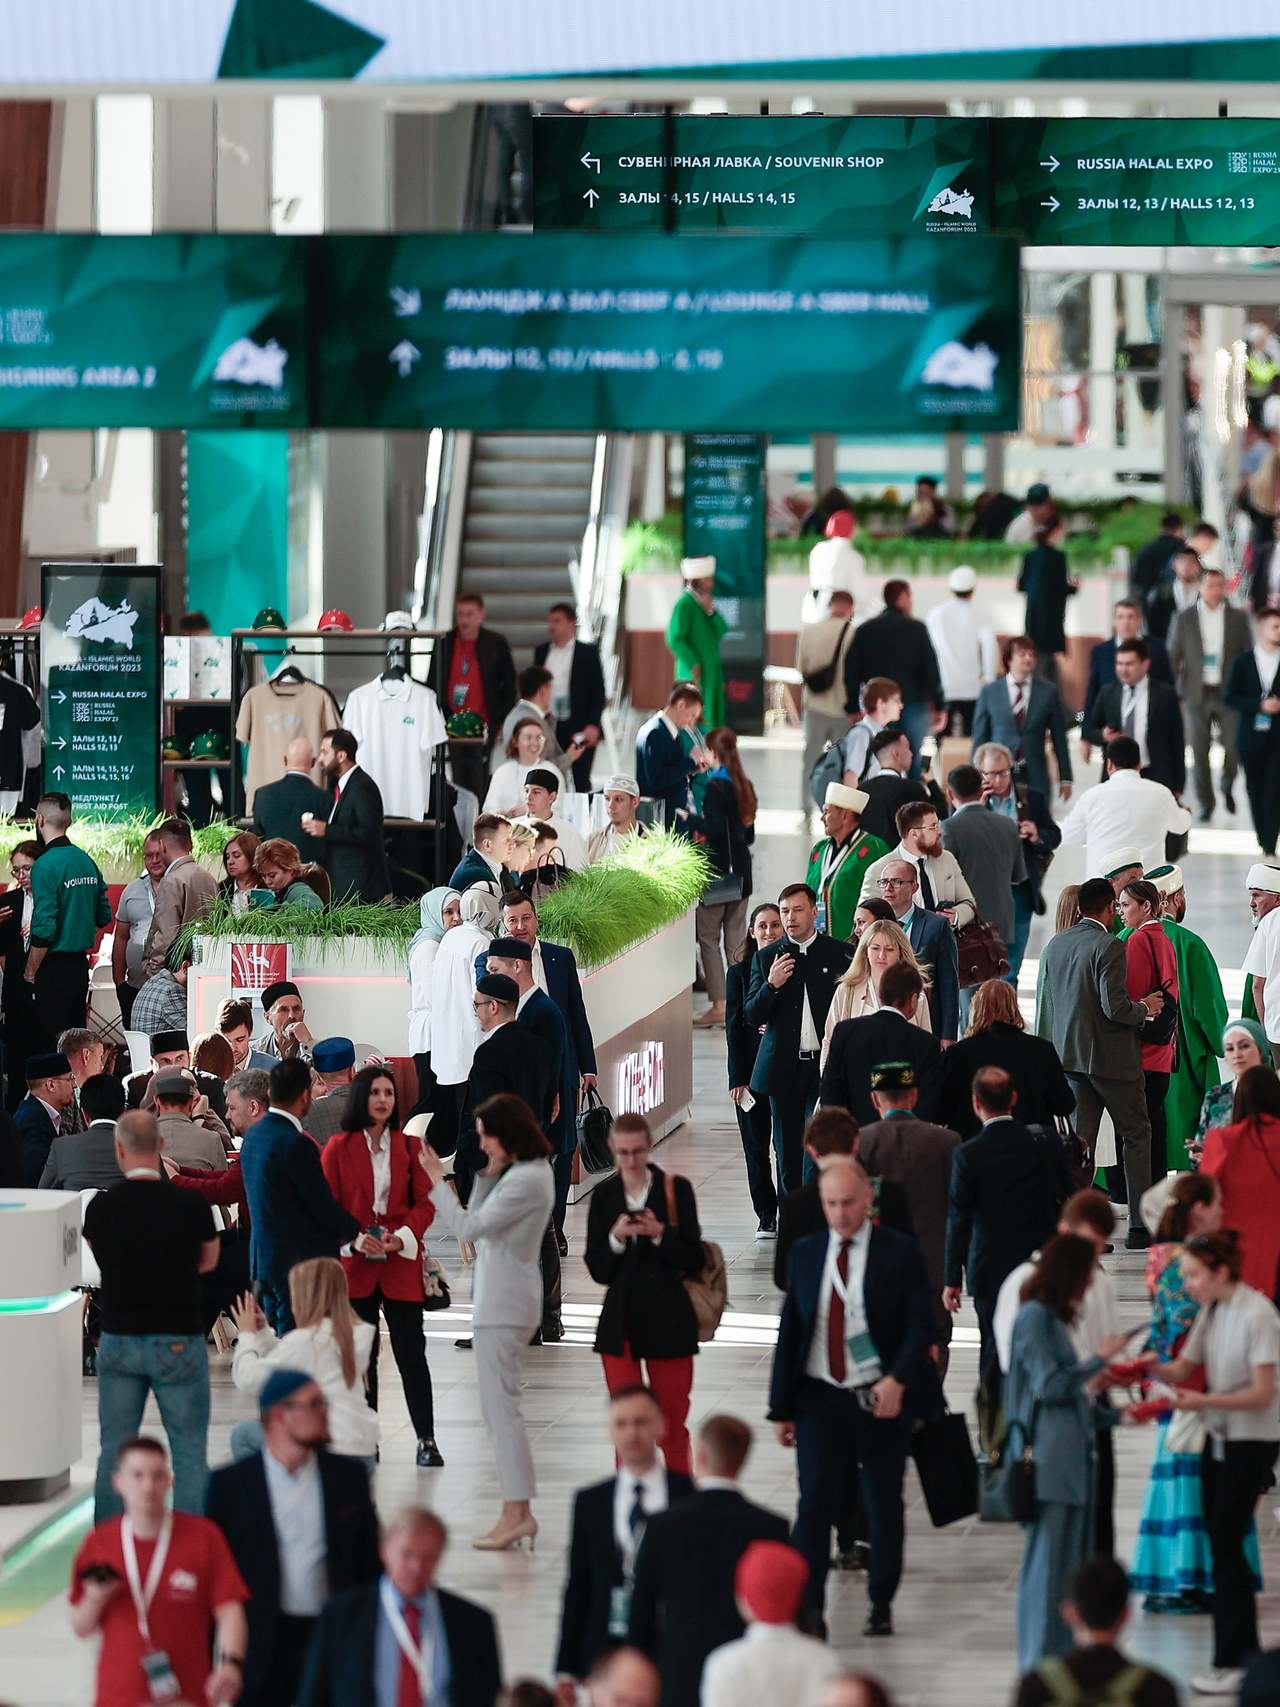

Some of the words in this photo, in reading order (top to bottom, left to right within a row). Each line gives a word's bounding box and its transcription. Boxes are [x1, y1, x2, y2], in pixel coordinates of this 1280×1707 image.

[713, 156, 762, 168] ЛАВКА
[764, 155, 772, 170] /
[774, 156, 844, 168] SOUVENIR
[847, 156, 885, 168] SHOP
[1077, 158, 1126, 170] RUSSIA
[1128, 158, 1174, 170] HALAL
[1176, 158, 1213, 170] EXPO
[618, 192, 660, 204] ЗАЛЫ
[663, 192, 682, 206] 4,
[685, 192, 700, 204] 15
[702, 191, 710, 206] /
[712, 192, 754, 204] HALLS
[757, 192, 778, 206] 14,
[780, 192, 796, 204] 15
[1077, 198, 1119, 210] ЗАЛЫ
[1122, 198, 1141, 212] 12,
[1144, 198, 1159, 210] 13
[1160, 197, 1168, 212] /
[1170, 198, 1213, 210] HALLS
[1216, 198, 1237, 212] 12,
[1239, 198, 1255, 210] 13
[58, 664, 119, 672] KAZANFORUM
[120, 664, 141, 672] 2023
[96, 735, 108, 743] 12,
[97, 744, 108, 752] 12,
[96, 765, 107, 773] 14,
[108, 765, 119, 773] 15,
